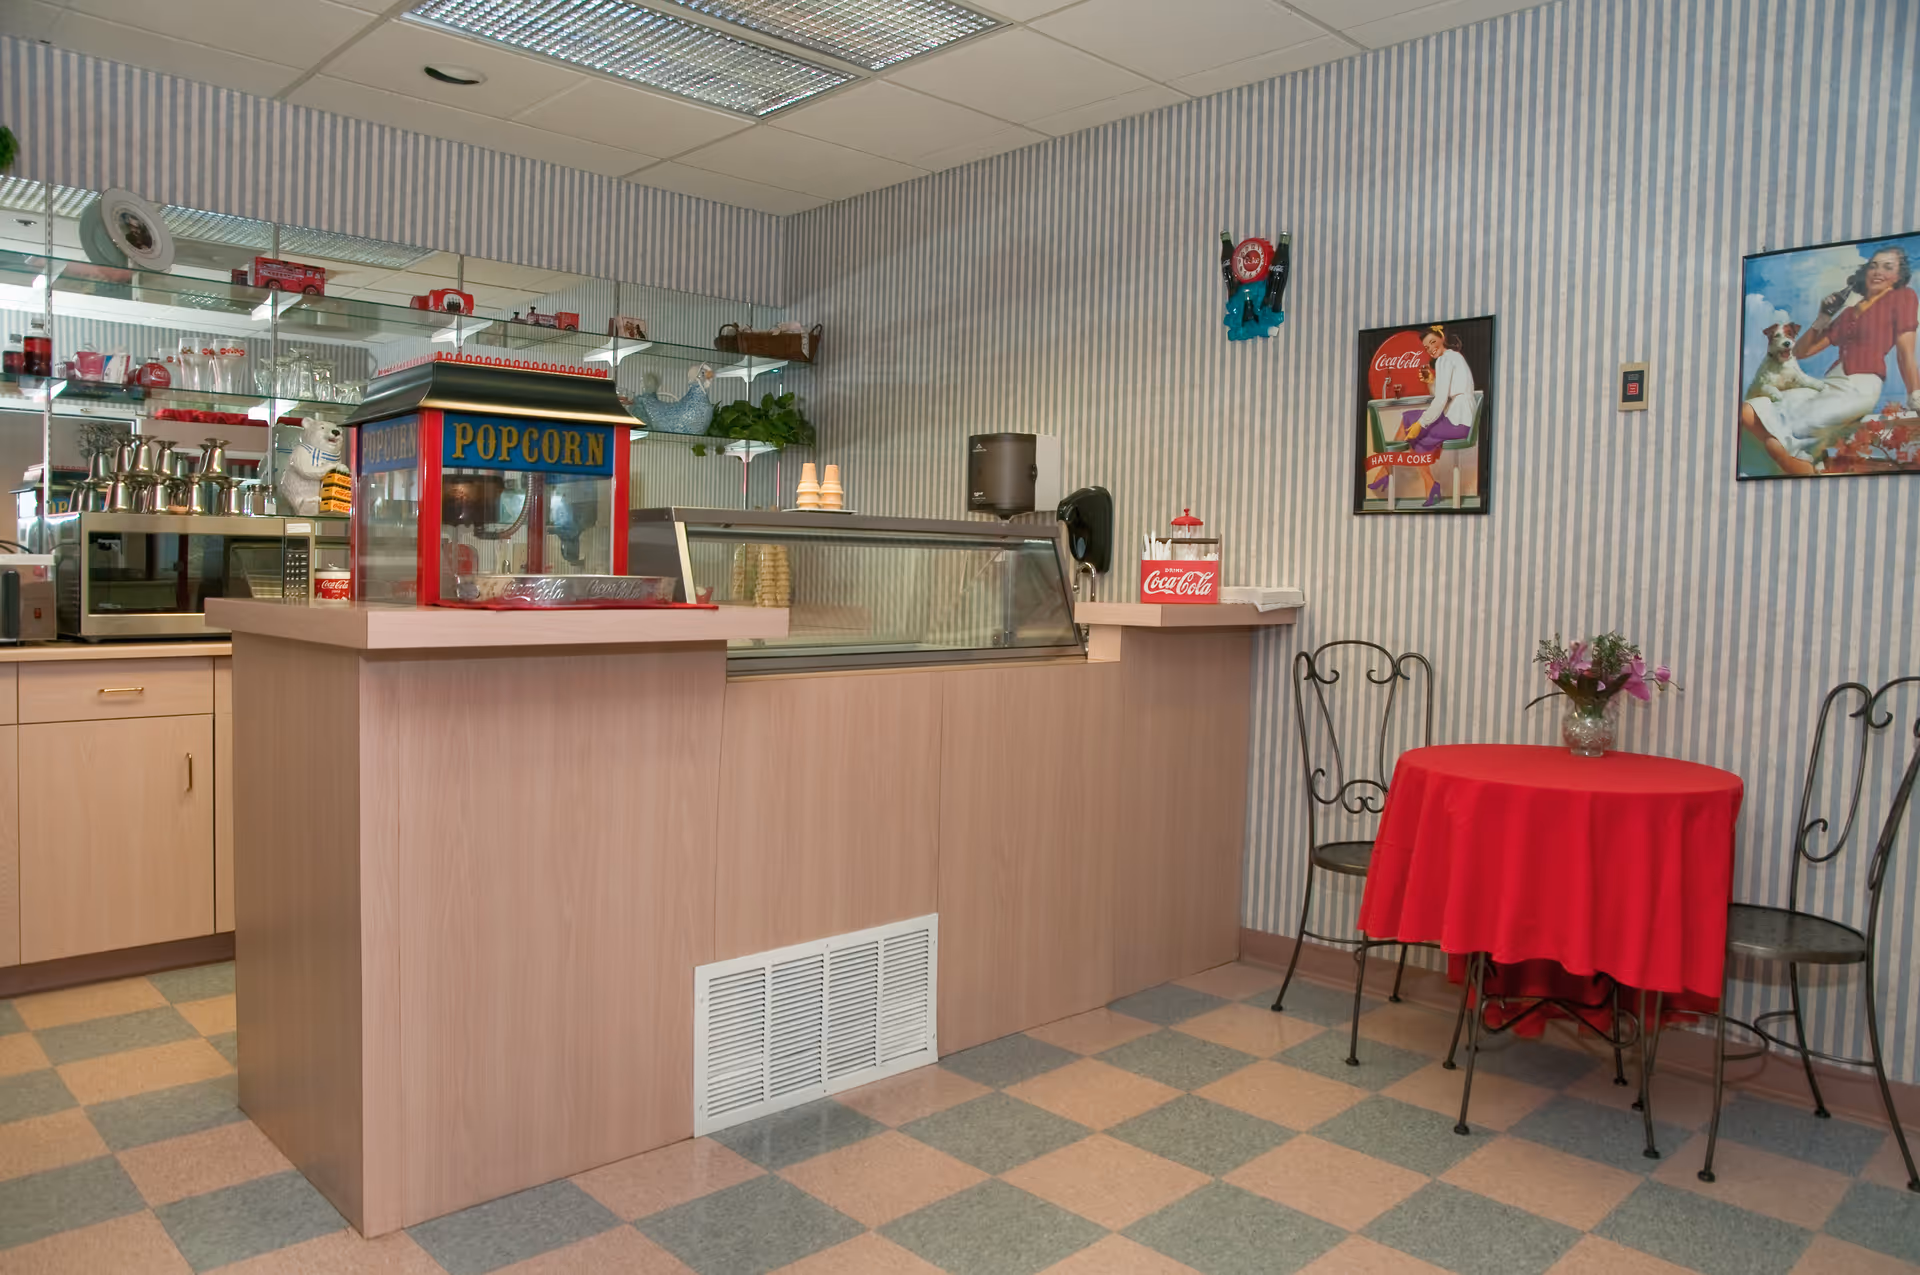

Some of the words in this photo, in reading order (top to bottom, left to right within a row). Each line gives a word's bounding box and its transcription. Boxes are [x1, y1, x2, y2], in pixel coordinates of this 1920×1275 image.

[1375, 351, 1423, 371] Coca-Cola
[363, 423, 417, 465] POPCORN
[452, 423, 605, 466] POPCORN
[1372, 454, 1393, 465] HAVE
[1397, 454, 1403, 463] A
[1407, 454, 1432, 464] COKE
[1144, 570, 1214, 595] Coca-Cola
